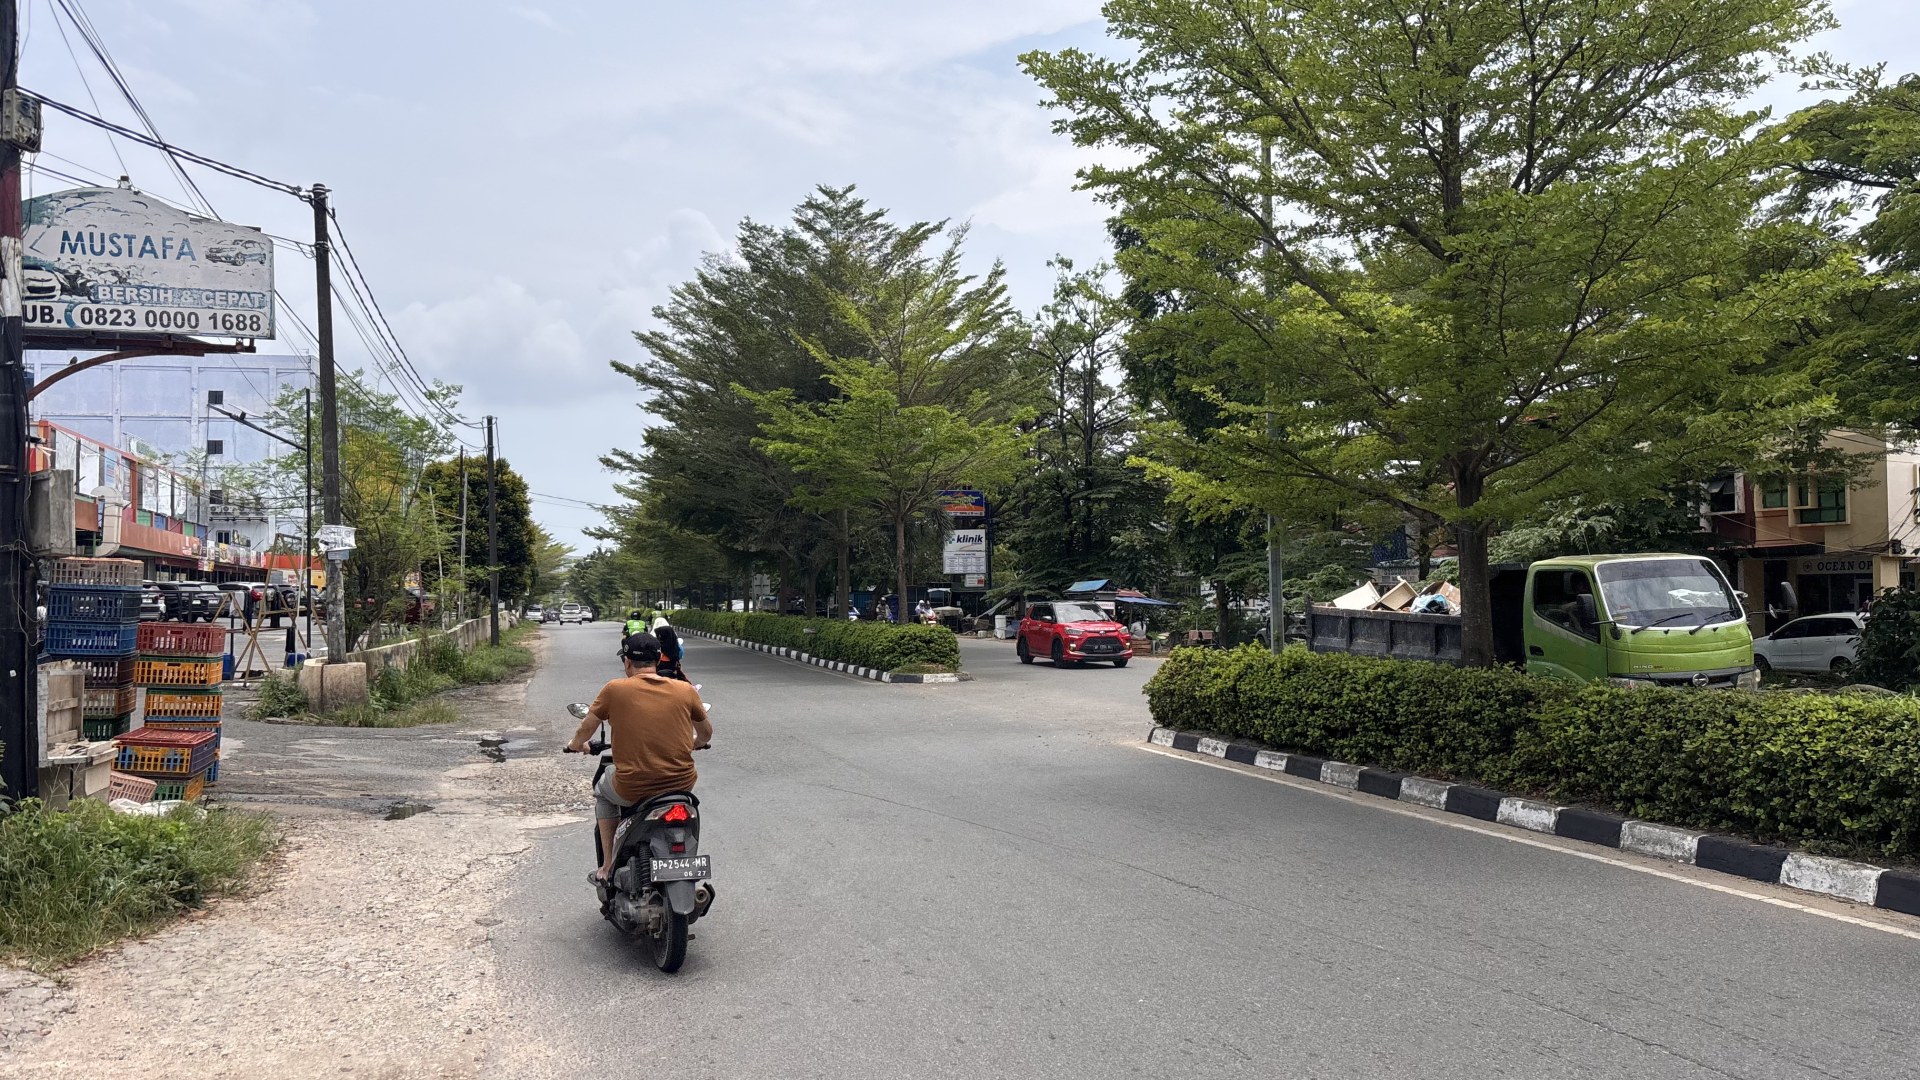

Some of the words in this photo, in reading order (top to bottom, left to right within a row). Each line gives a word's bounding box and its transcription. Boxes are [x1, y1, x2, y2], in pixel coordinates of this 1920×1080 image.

[59, 230, 197, 262] MUSTAFA
[98, 286, 173, 303] BERSIH
[201, 292, 264, 308] CEPAT
[22, 304, 62, 324] UB.
[80, 307, 137, 327] 0823
[144, 309, 200, 329] 0000
[208, 313, 262, 332] 1688
[956, 534, 984, 544] klinik
[1817, 561, 1855, 571] OCEAN
[652, 860, 664, 870] BP
[668, 859, 690, 869] 2544
[695, 857, 707, 867] MR
